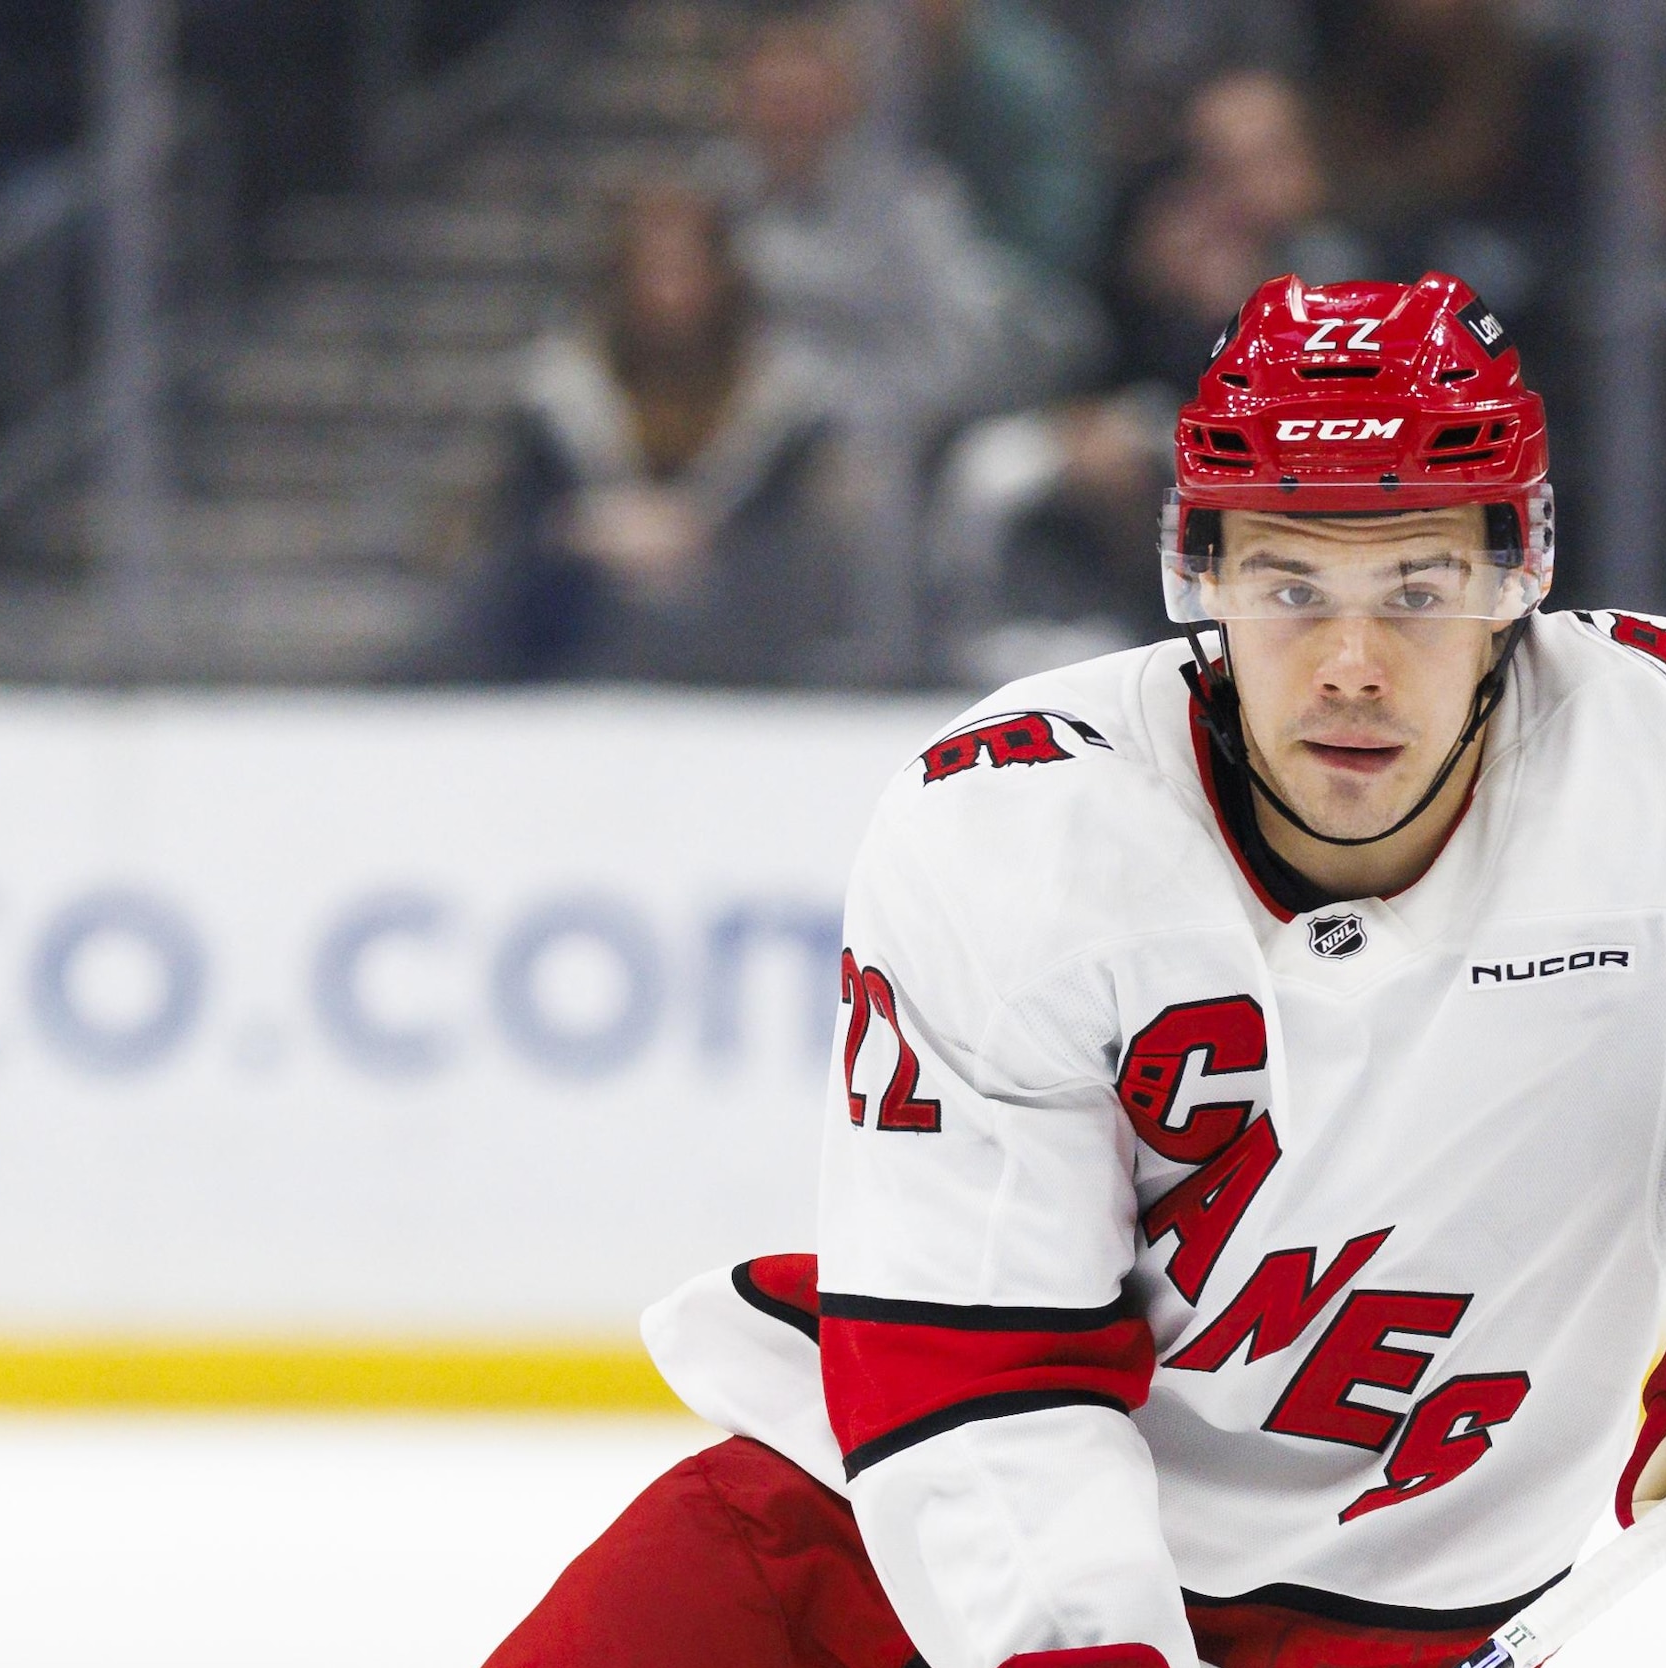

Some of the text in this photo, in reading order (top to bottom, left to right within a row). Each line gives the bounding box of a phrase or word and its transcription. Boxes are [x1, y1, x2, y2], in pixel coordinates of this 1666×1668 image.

[1303, 316, 1384, 352] 22
[1468, 313, 1504, 345] Len
[1275, 418, 1405, 441] CCM
[1320, 923, 1356, 953] NHL
[1471, 950, 1630, 985] NUCOR
[841, 946, 942, 1133] 22
[1116, 993, 1532, 1526] CANES
